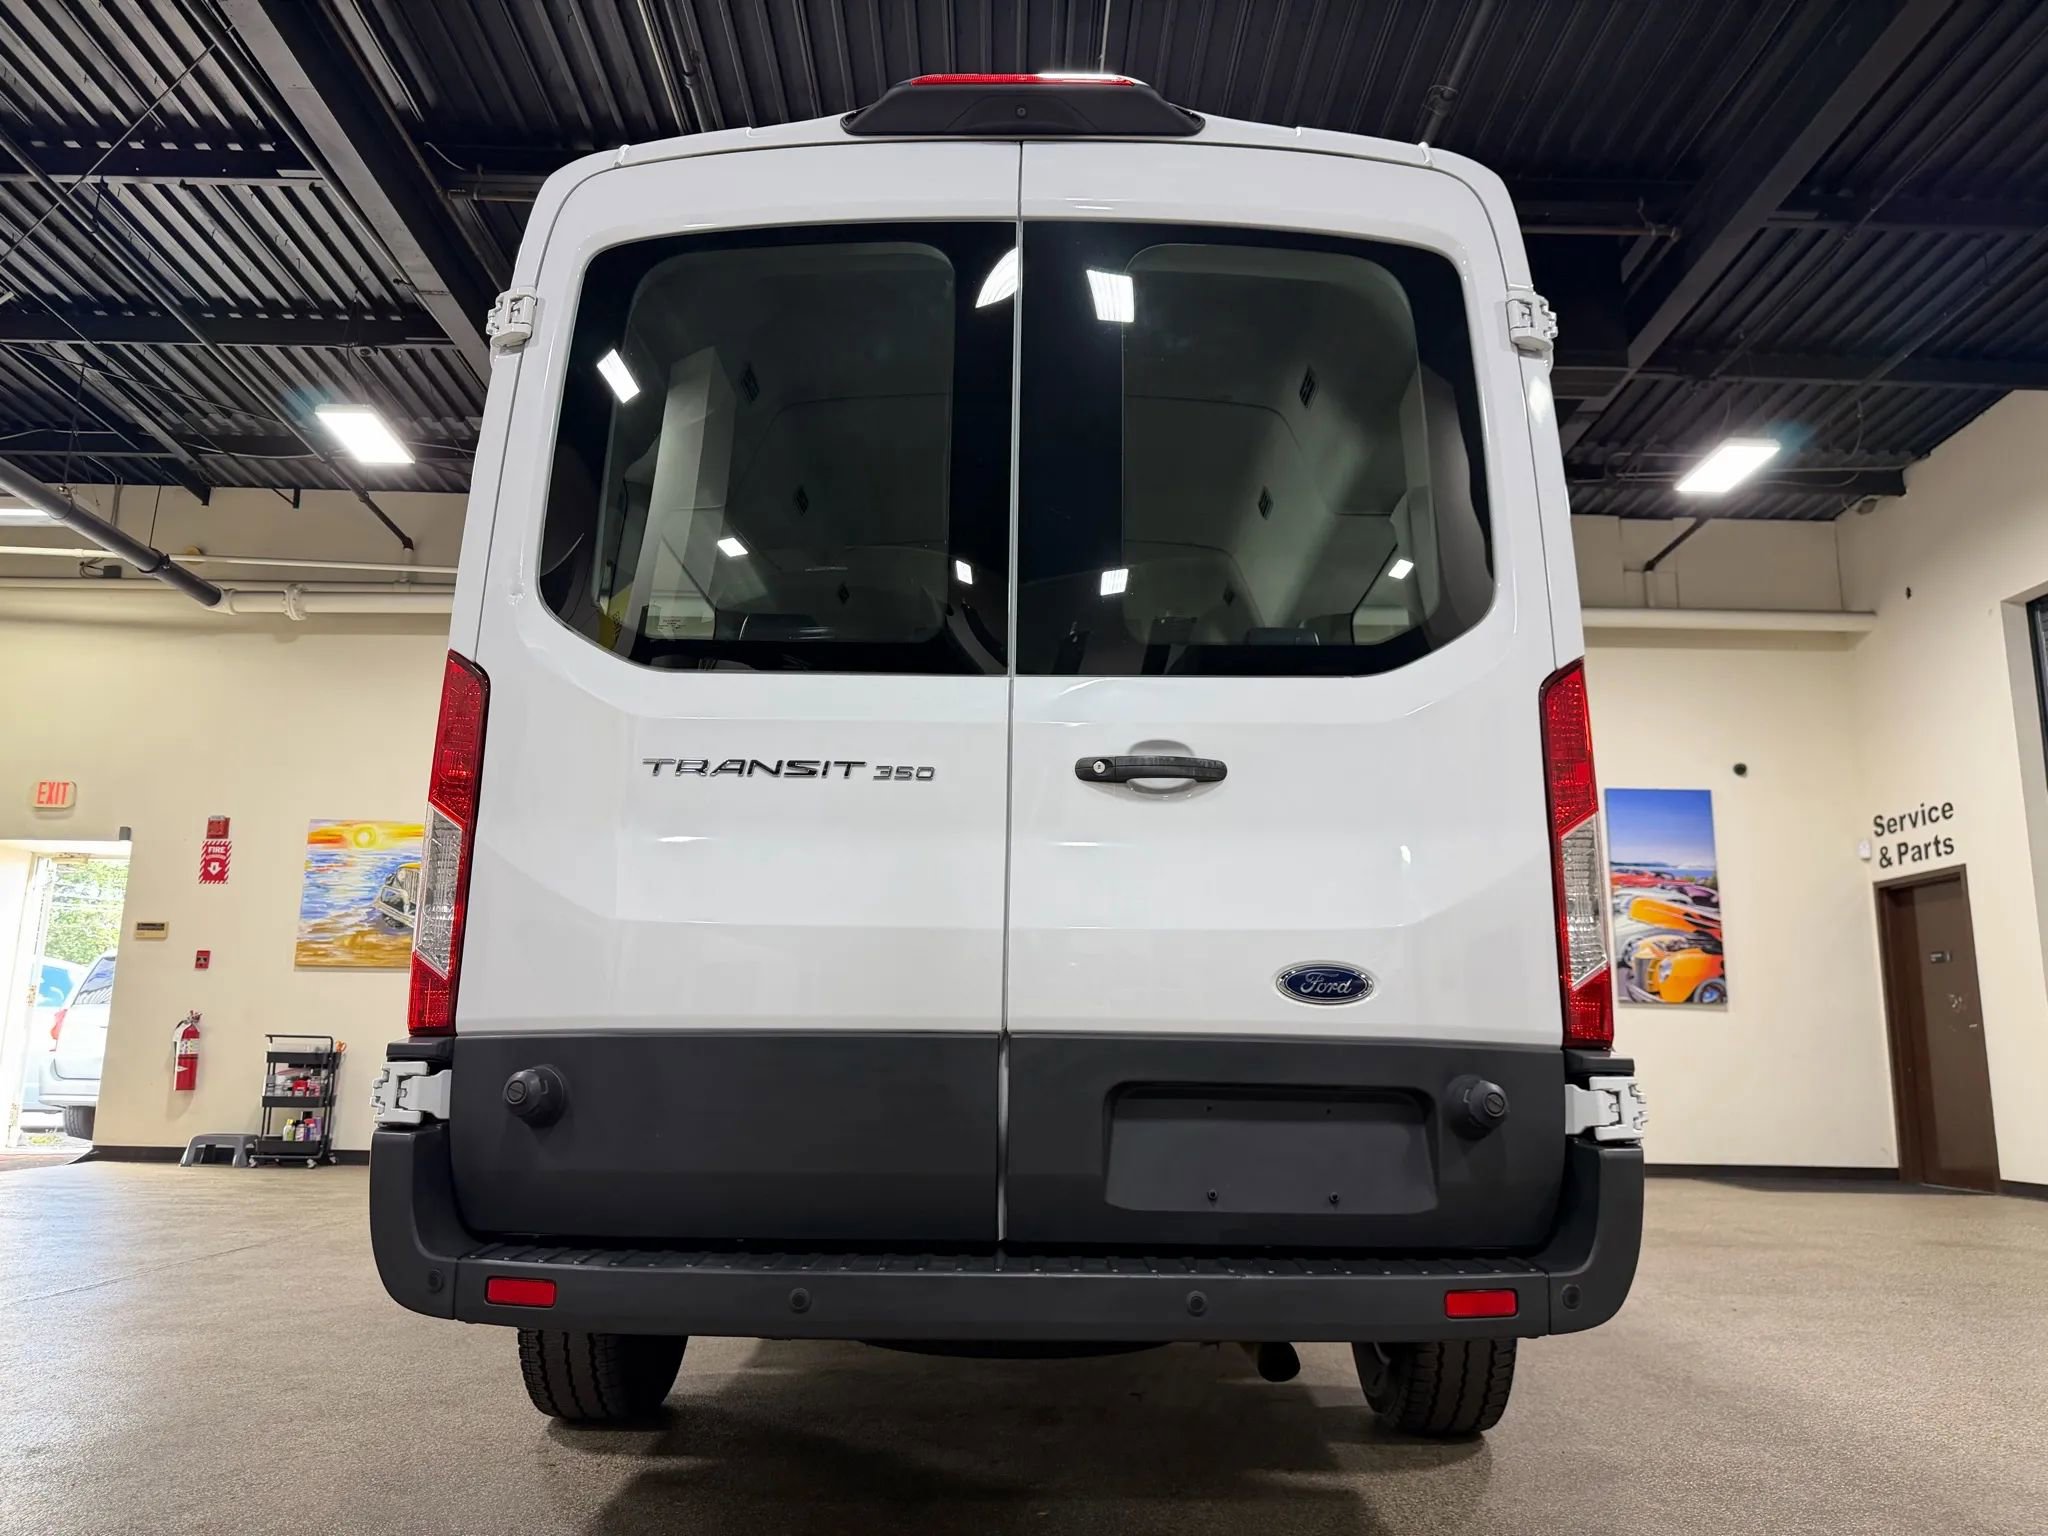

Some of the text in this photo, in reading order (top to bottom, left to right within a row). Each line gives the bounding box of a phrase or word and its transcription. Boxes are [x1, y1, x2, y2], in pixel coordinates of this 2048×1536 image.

[642, 758, 936, 781] TRANSIT 350
[36, 781, 70, 805] EXIT
[1873, 802, 1955, 838] Service
[1879, 834, 1955, 869] & Parts
[1300, 971, 1353, 995] Ford
